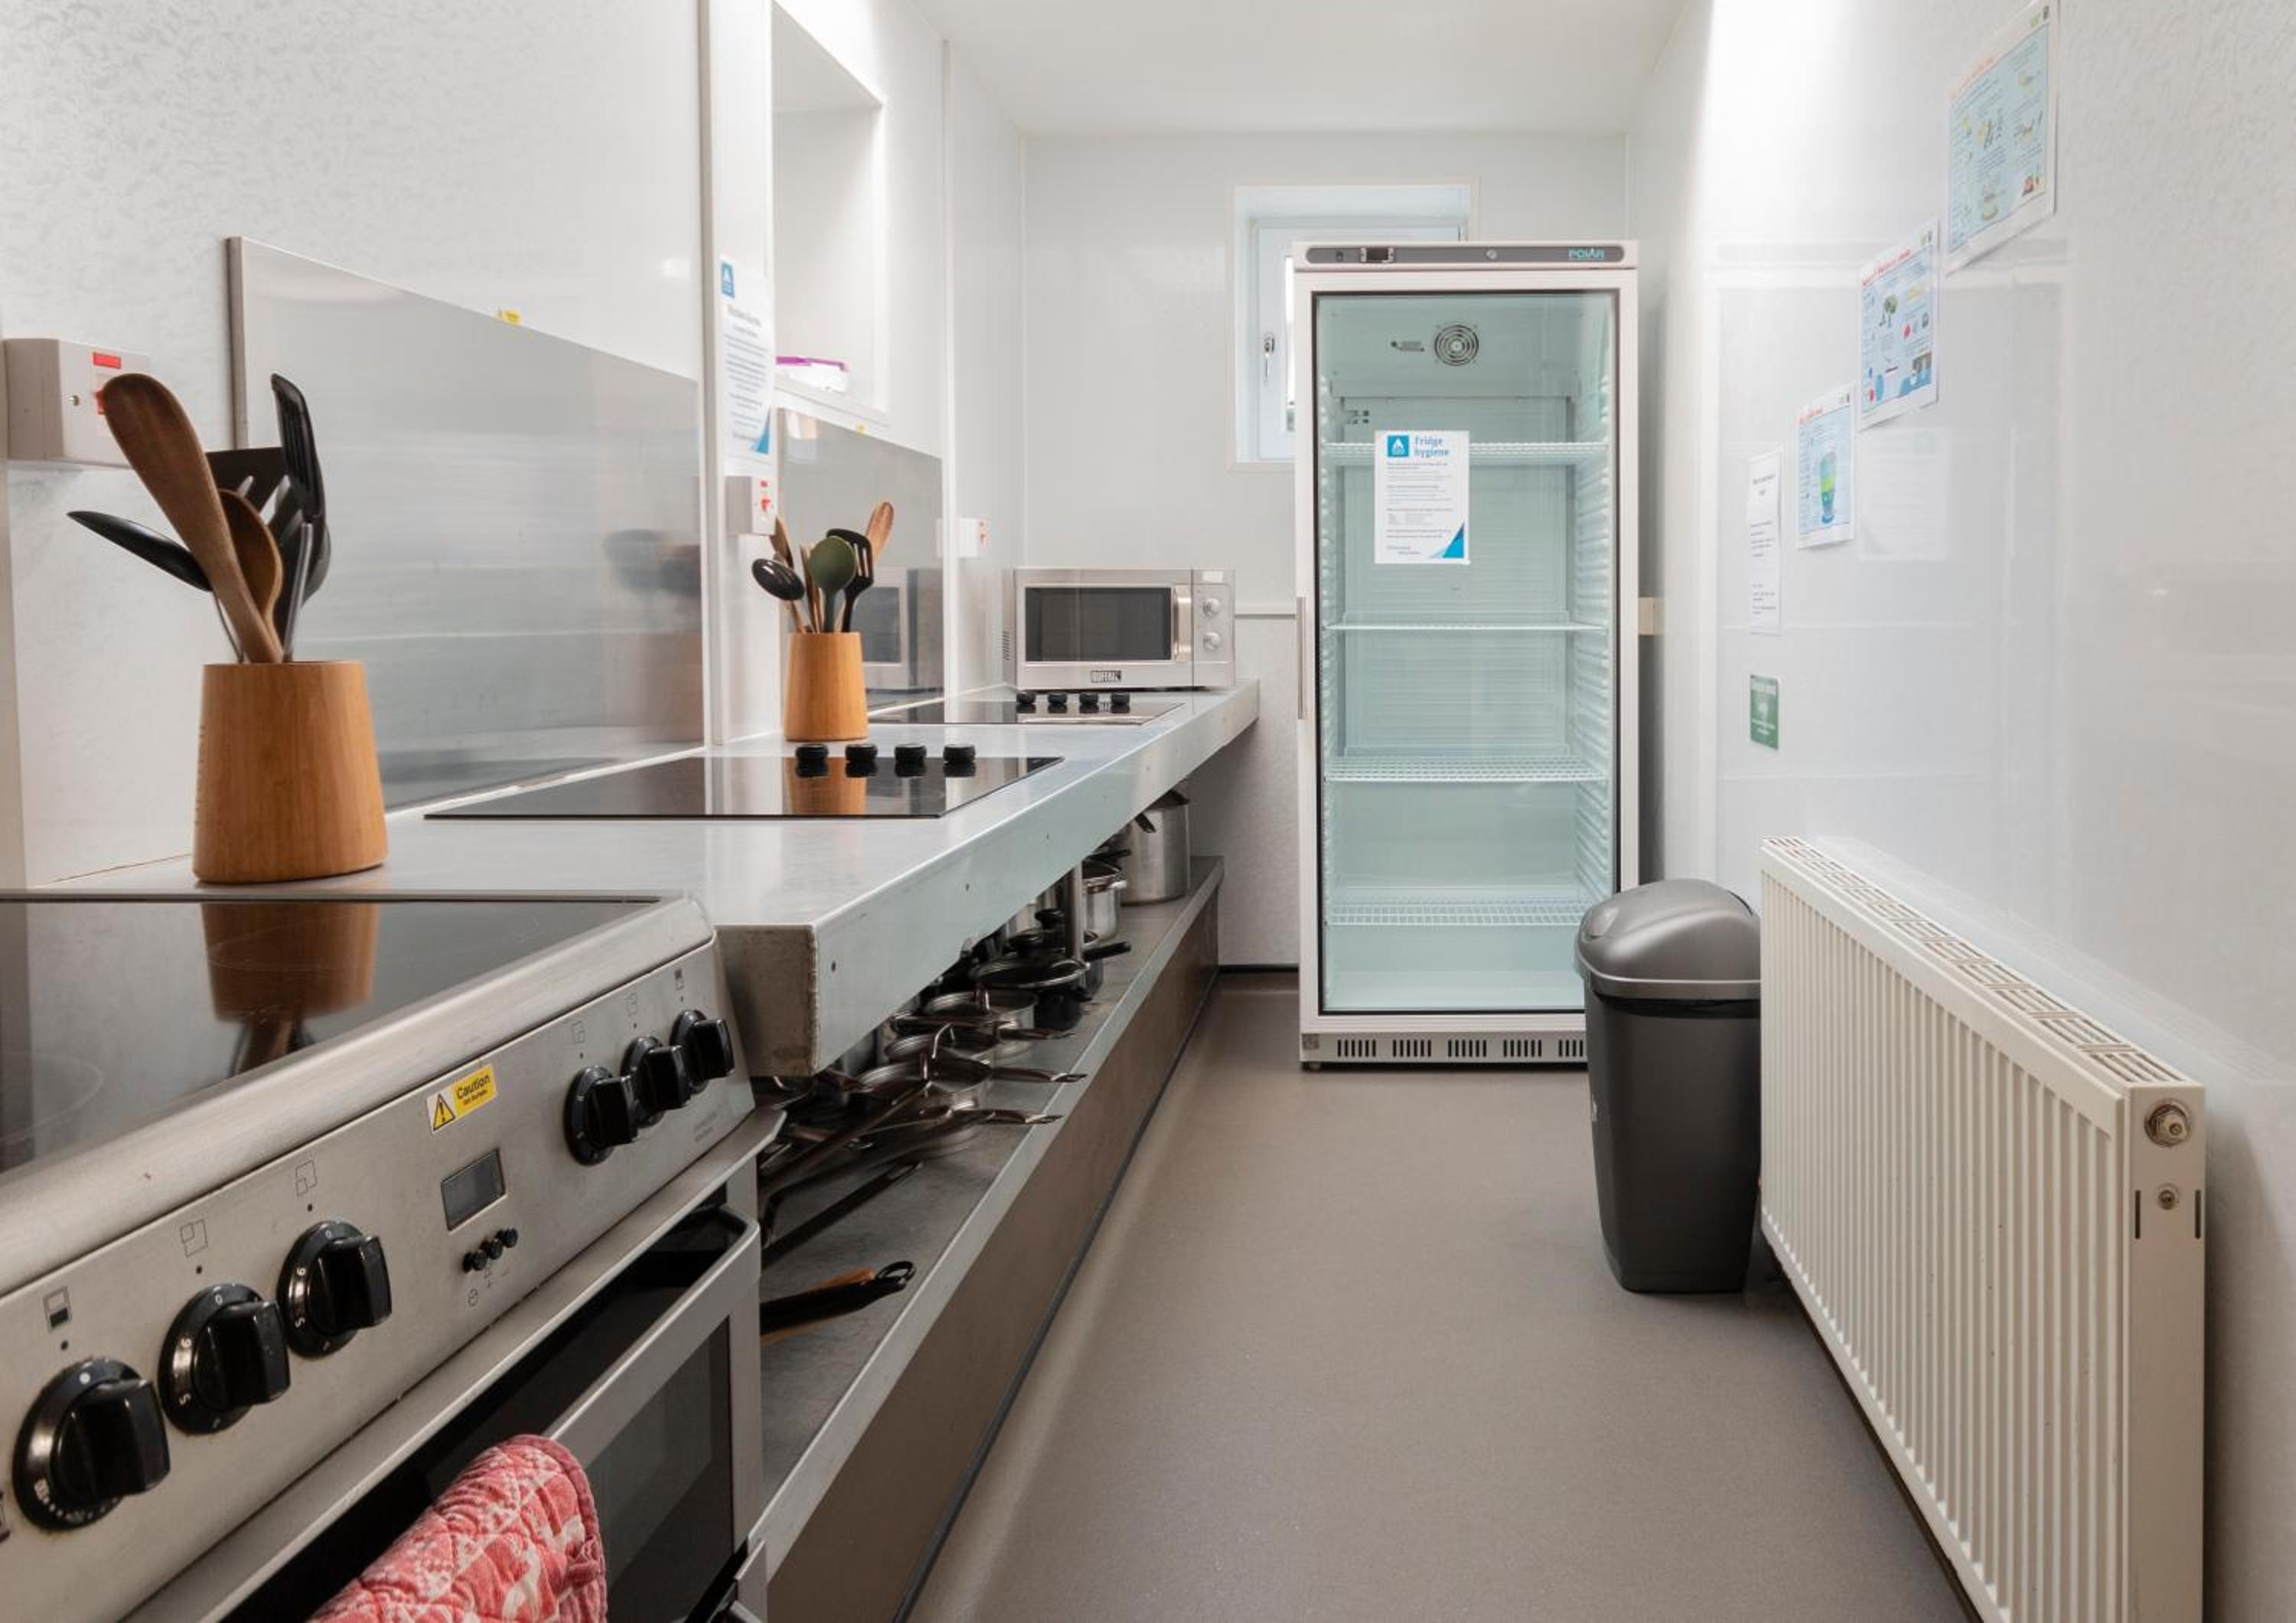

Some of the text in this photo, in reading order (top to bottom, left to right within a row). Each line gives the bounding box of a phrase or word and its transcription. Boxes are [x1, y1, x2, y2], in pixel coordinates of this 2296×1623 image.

[1567, 247, 1605, 258] POLAR
[1415, 436, 1444, 447] Fridge
[1414, 447, 1450, 459] hygiene
[456, 1074, 491, 1099] Caution
